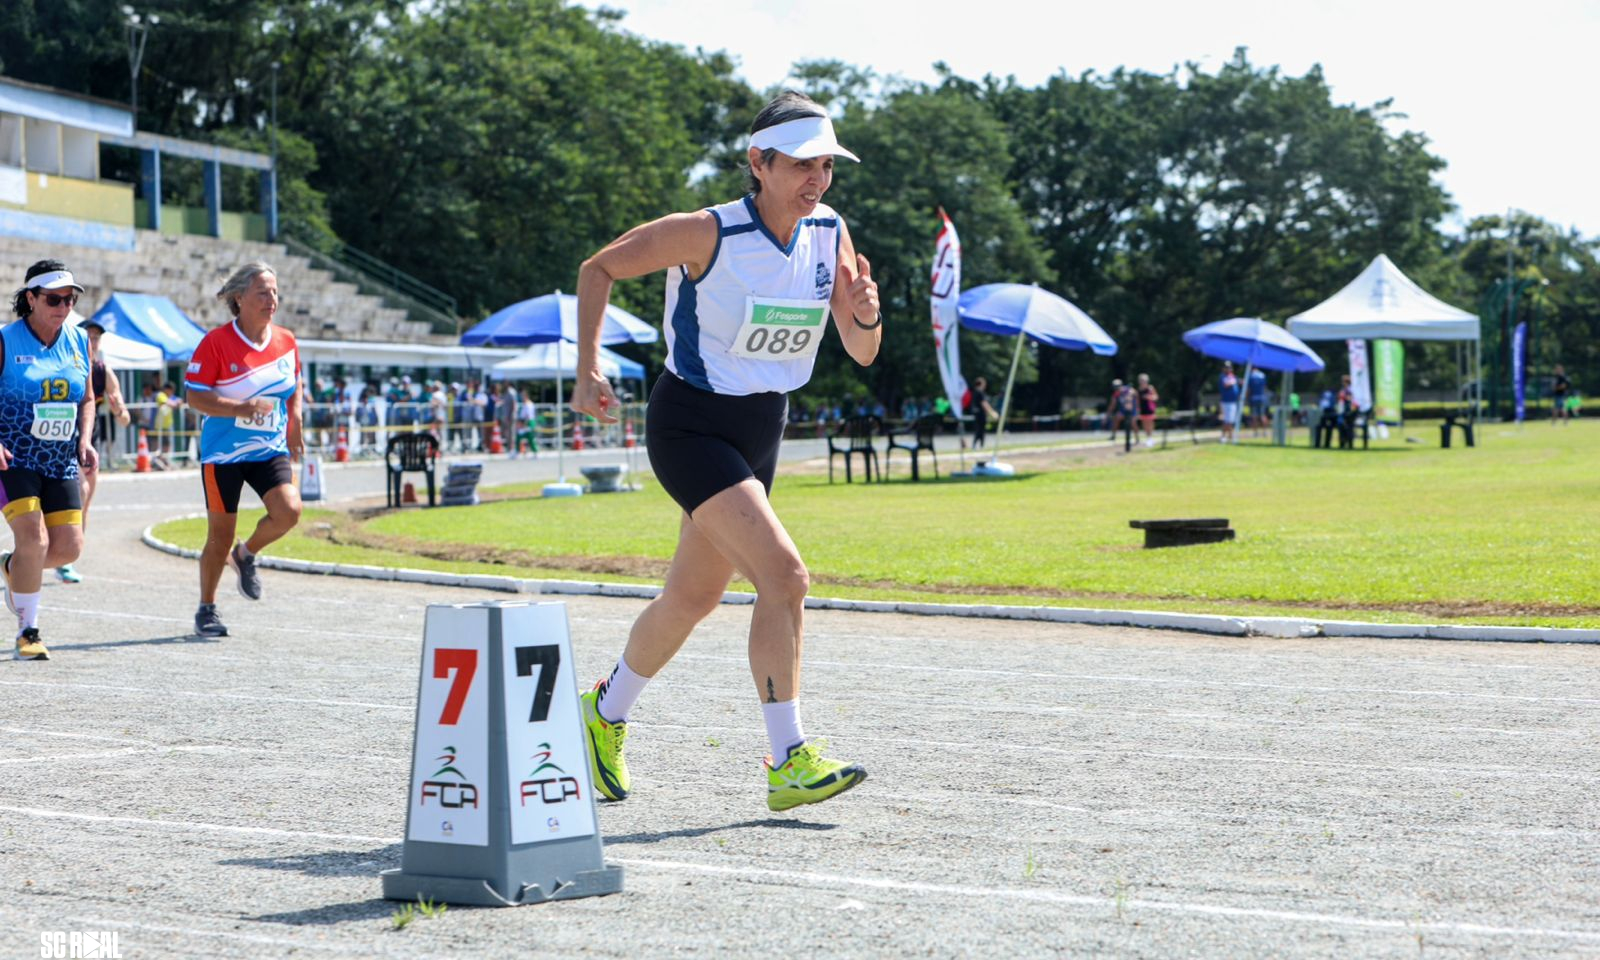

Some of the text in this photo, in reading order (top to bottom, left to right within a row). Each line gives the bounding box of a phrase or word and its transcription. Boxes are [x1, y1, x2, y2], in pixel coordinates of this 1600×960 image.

[775, 311, 808, 321] Fesporte
[745, 327, 811, 354] 089
[41, 378, 70, 401] 13
[38, 420, 72, 437] 050
[433, 648, 478, 726] 7
[515, 644, 560, 723] 7
[421, 780, 478, 809] FCA
[520, 776, 581, 807] FCA
